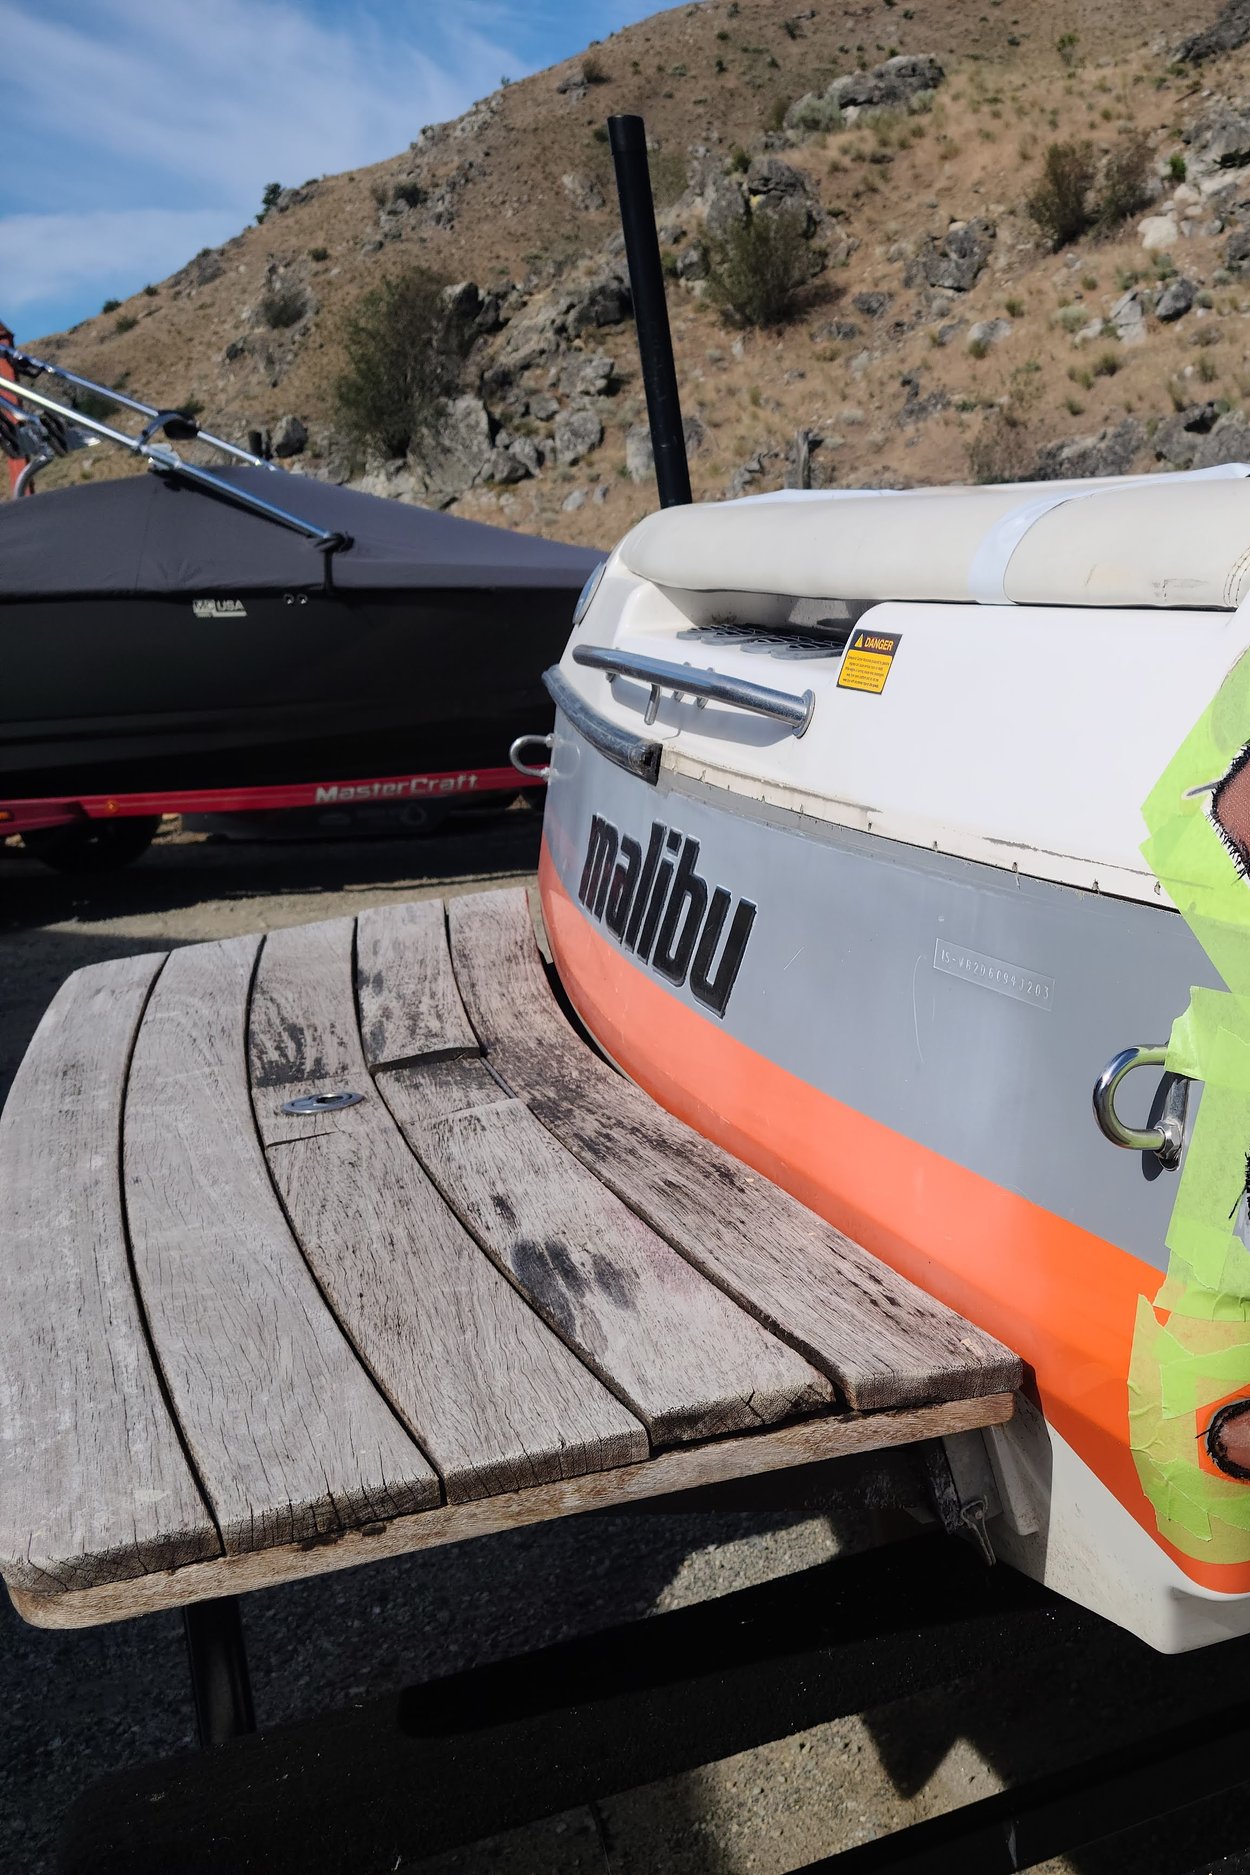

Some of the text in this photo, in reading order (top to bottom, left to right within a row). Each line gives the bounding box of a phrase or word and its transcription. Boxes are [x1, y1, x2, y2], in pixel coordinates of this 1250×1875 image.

[864, 637, 894, 651] DANGER
[315, 774, 478, 804] MasterCraft
[579, 812, 758, 1020] malibu
